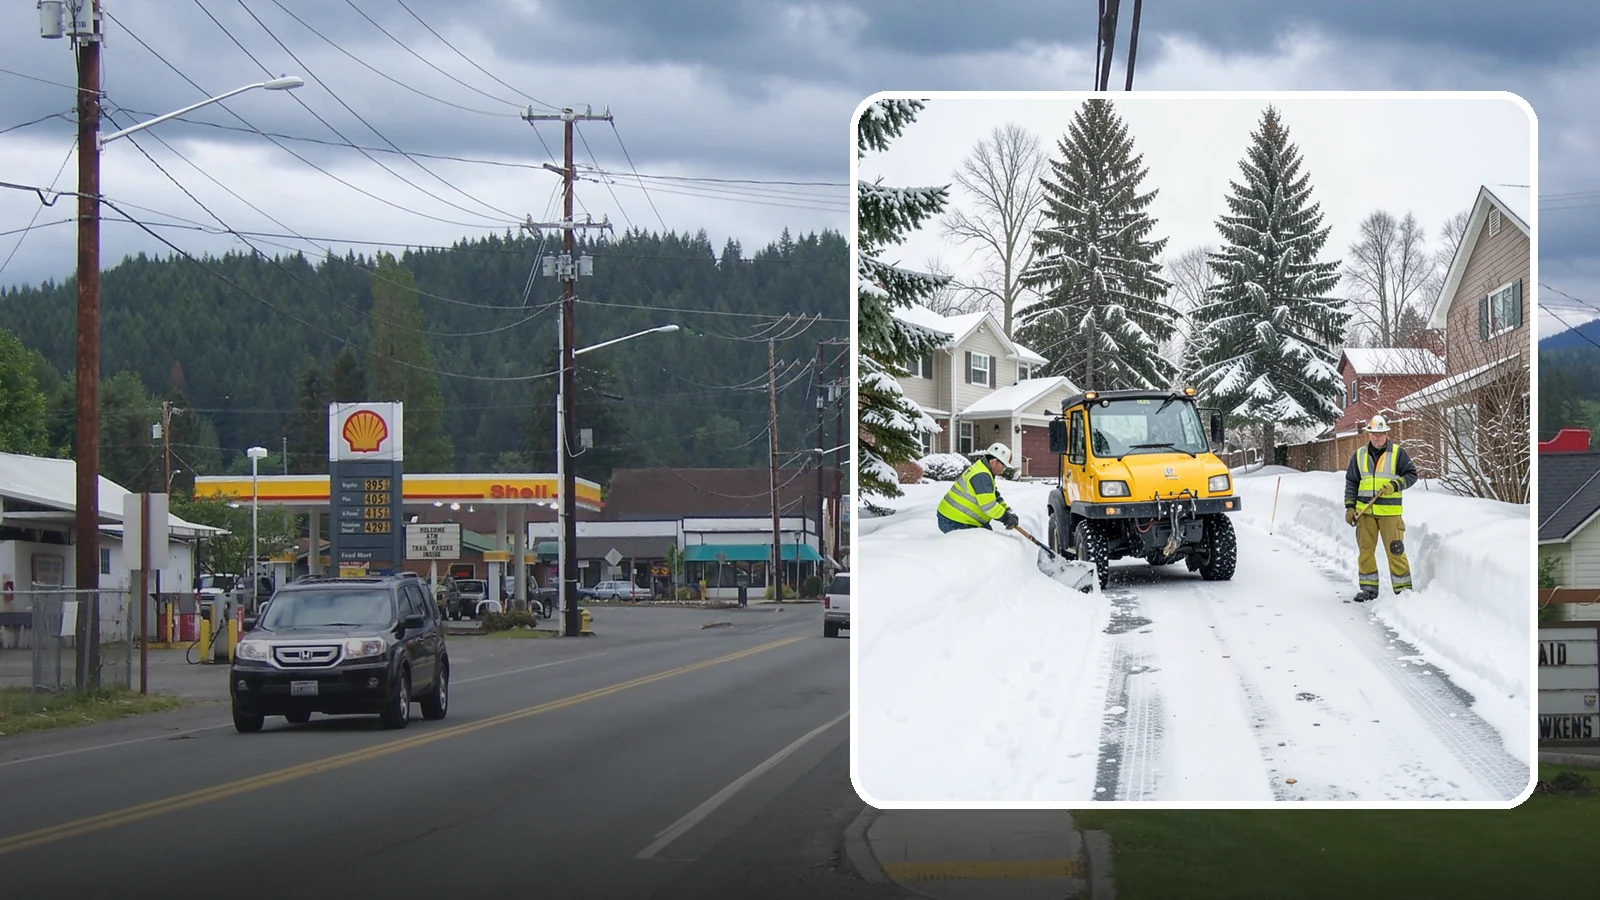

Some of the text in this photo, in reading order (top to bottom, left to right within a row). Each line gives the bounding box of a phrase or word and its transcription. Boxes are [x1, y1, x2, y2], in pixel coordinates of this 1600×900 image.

[342, 481, 358, 489] Regular
[366, 480, 384, 490] 395
[490, 484, 548, 499] Shell
[366, 494, 384, 504] 405
[366, 508, 384, 518] 415
[366, 522, 384, 533] 429
